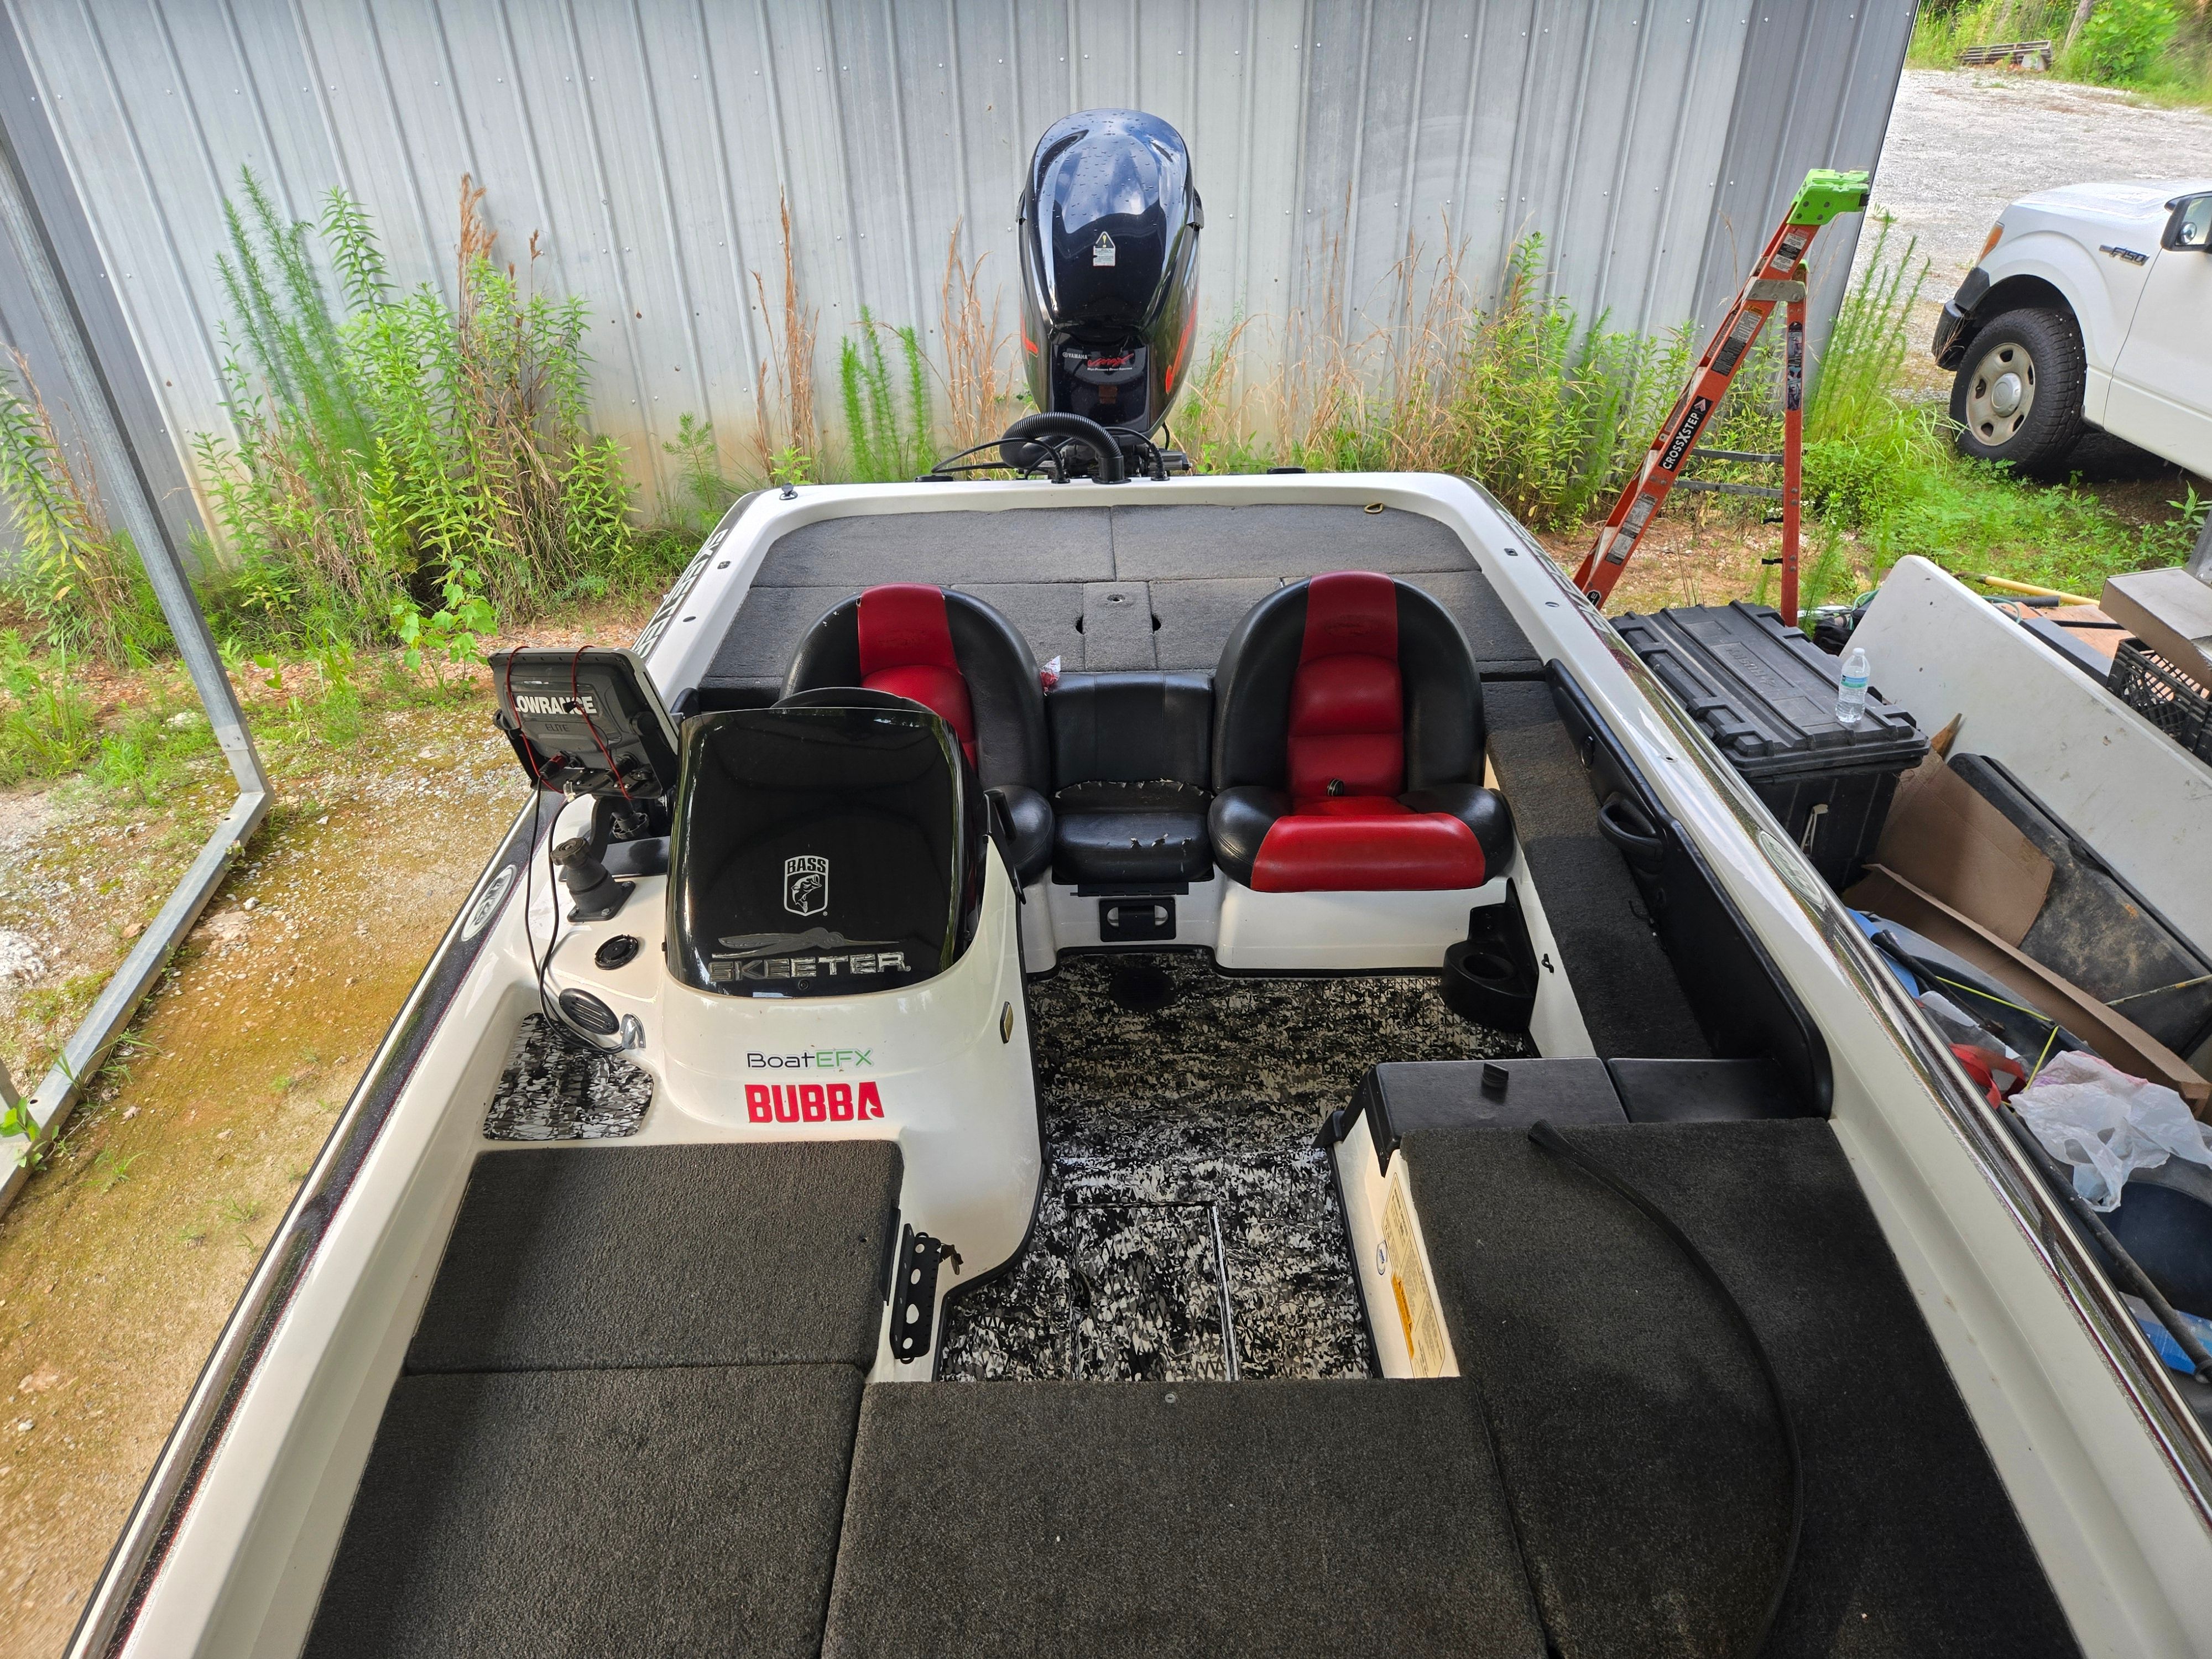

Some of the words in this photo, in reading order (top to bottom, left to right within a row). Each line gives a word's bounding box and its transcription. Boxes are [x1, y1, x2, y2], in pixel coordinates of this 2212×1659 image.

[545, 723, 570, 732] ELITE
[787, 857, 827, 873] BASS
[708, 951, 906, 982] SKEETER
[747, 1048, 874, 1069] BoatEFX
[744, 1081, 885, 1123] BUBBA
